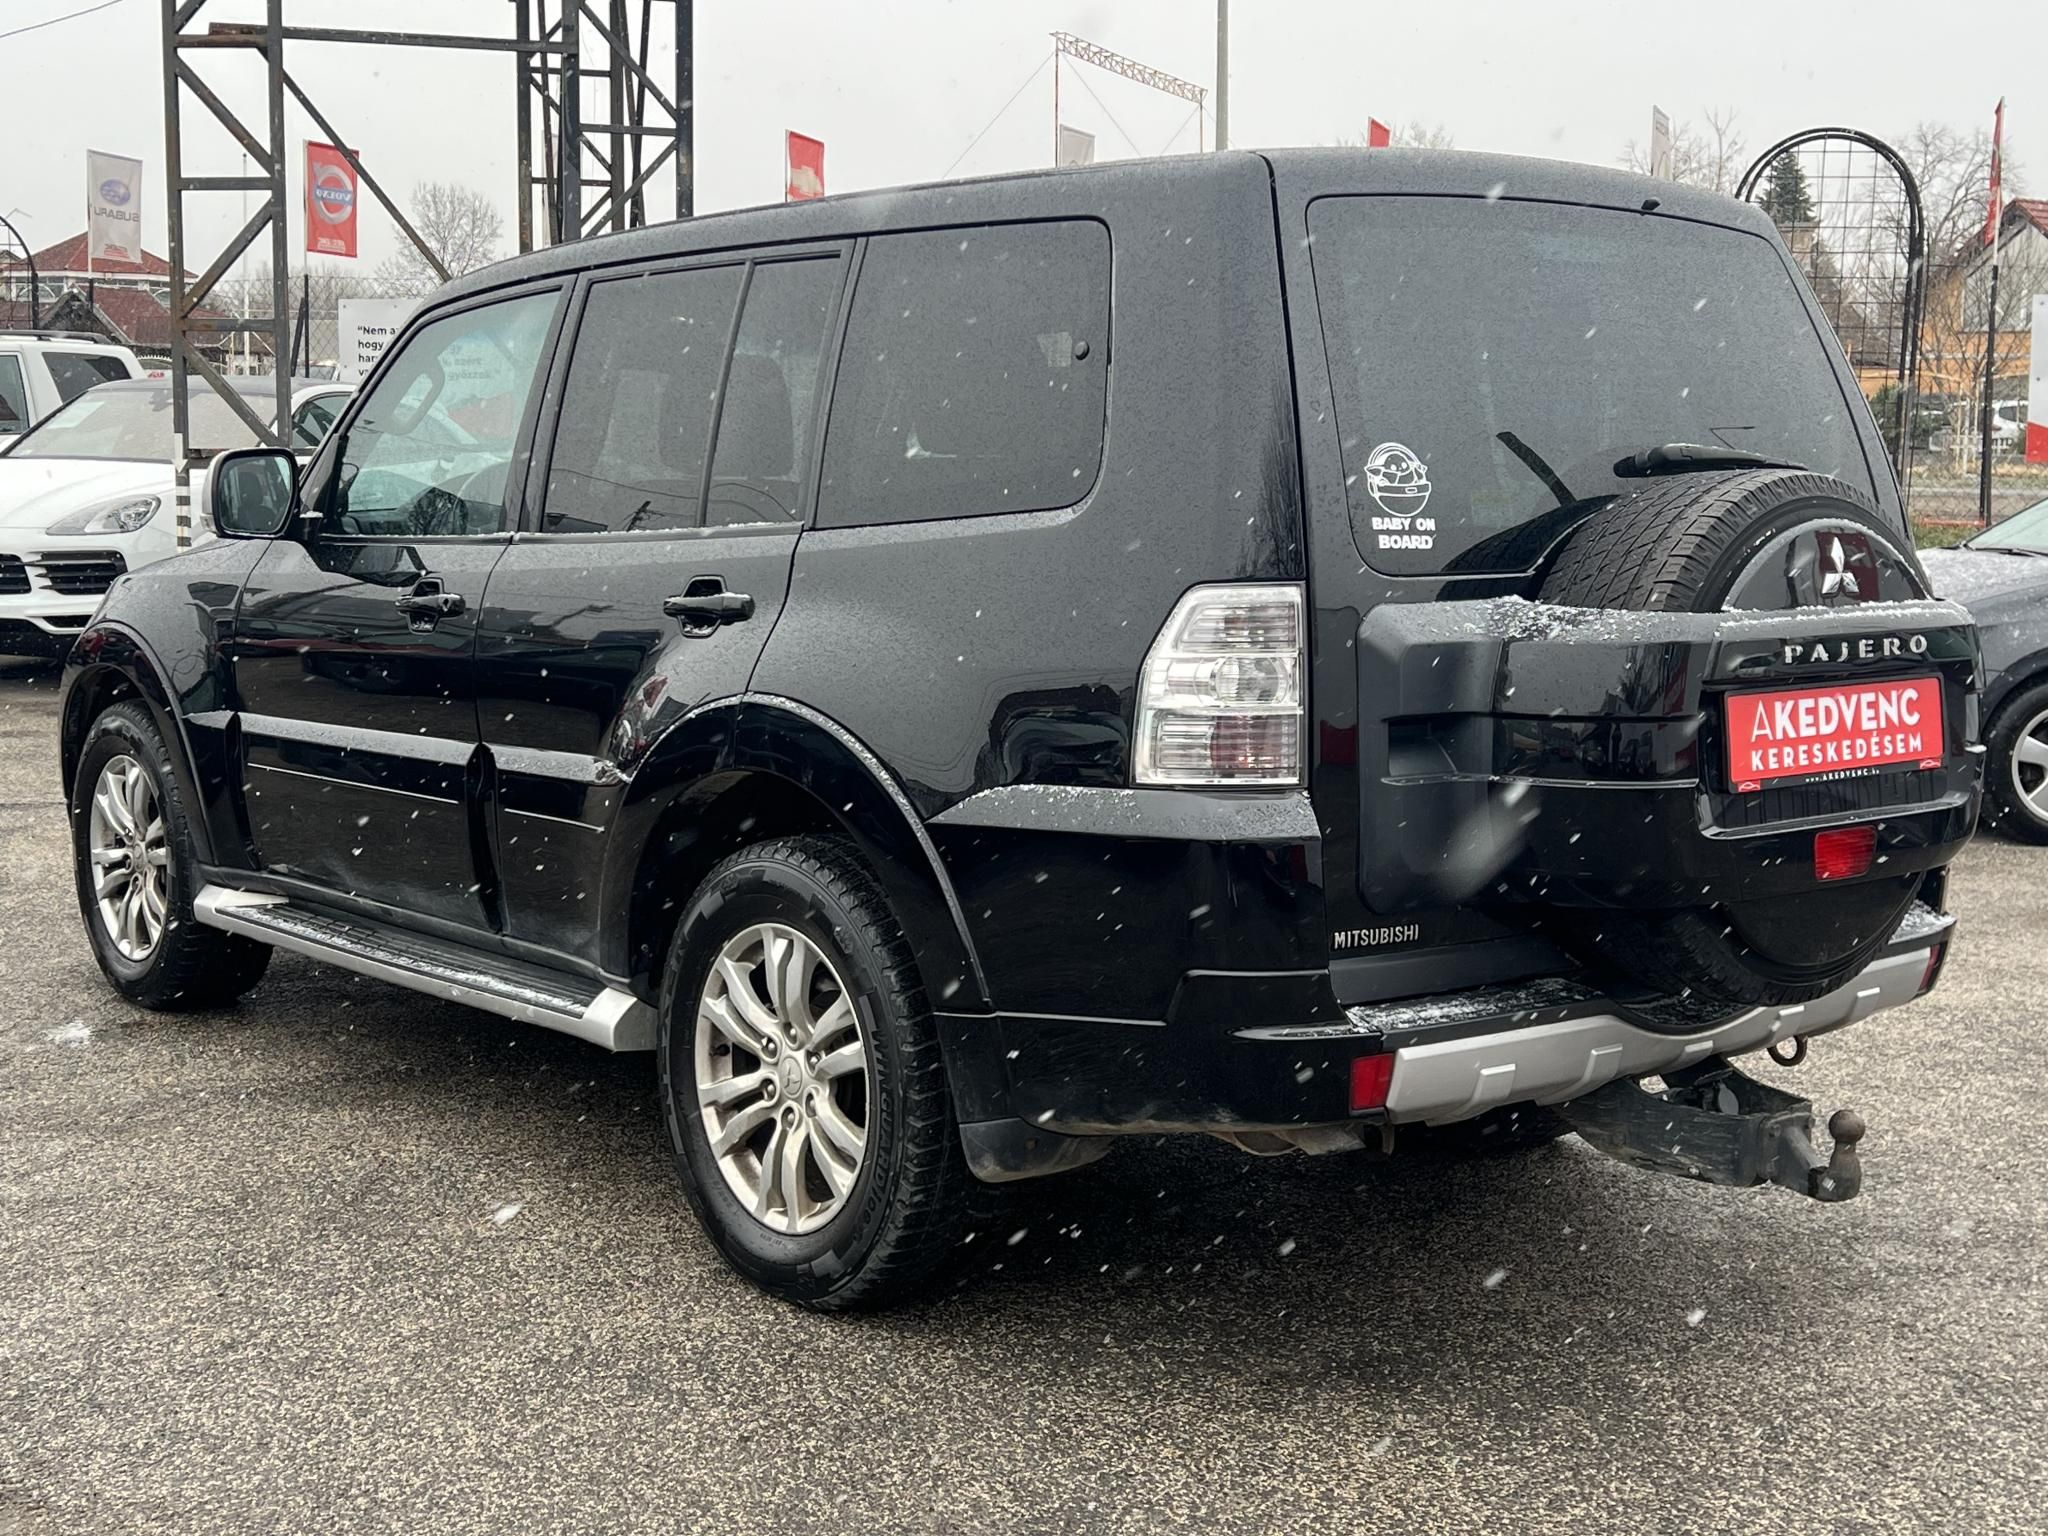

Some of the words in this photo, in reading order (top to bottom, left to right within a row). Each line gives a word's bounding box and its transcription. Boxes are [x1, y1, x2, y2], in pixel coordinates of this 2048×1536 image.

[358, 340, 384, 351] hogy
[1372, 517, 1411, 530] BABY
[1415, 517, 1436, 531] ON
[1378, 534, 1433, 549] BOARD
[1784, 634, 1928, 664] PAJERO
[1751, 731, 1922, 772] KERESKEDÉSEM
[1334, 923, 1419, 949] MITSUBISHI
